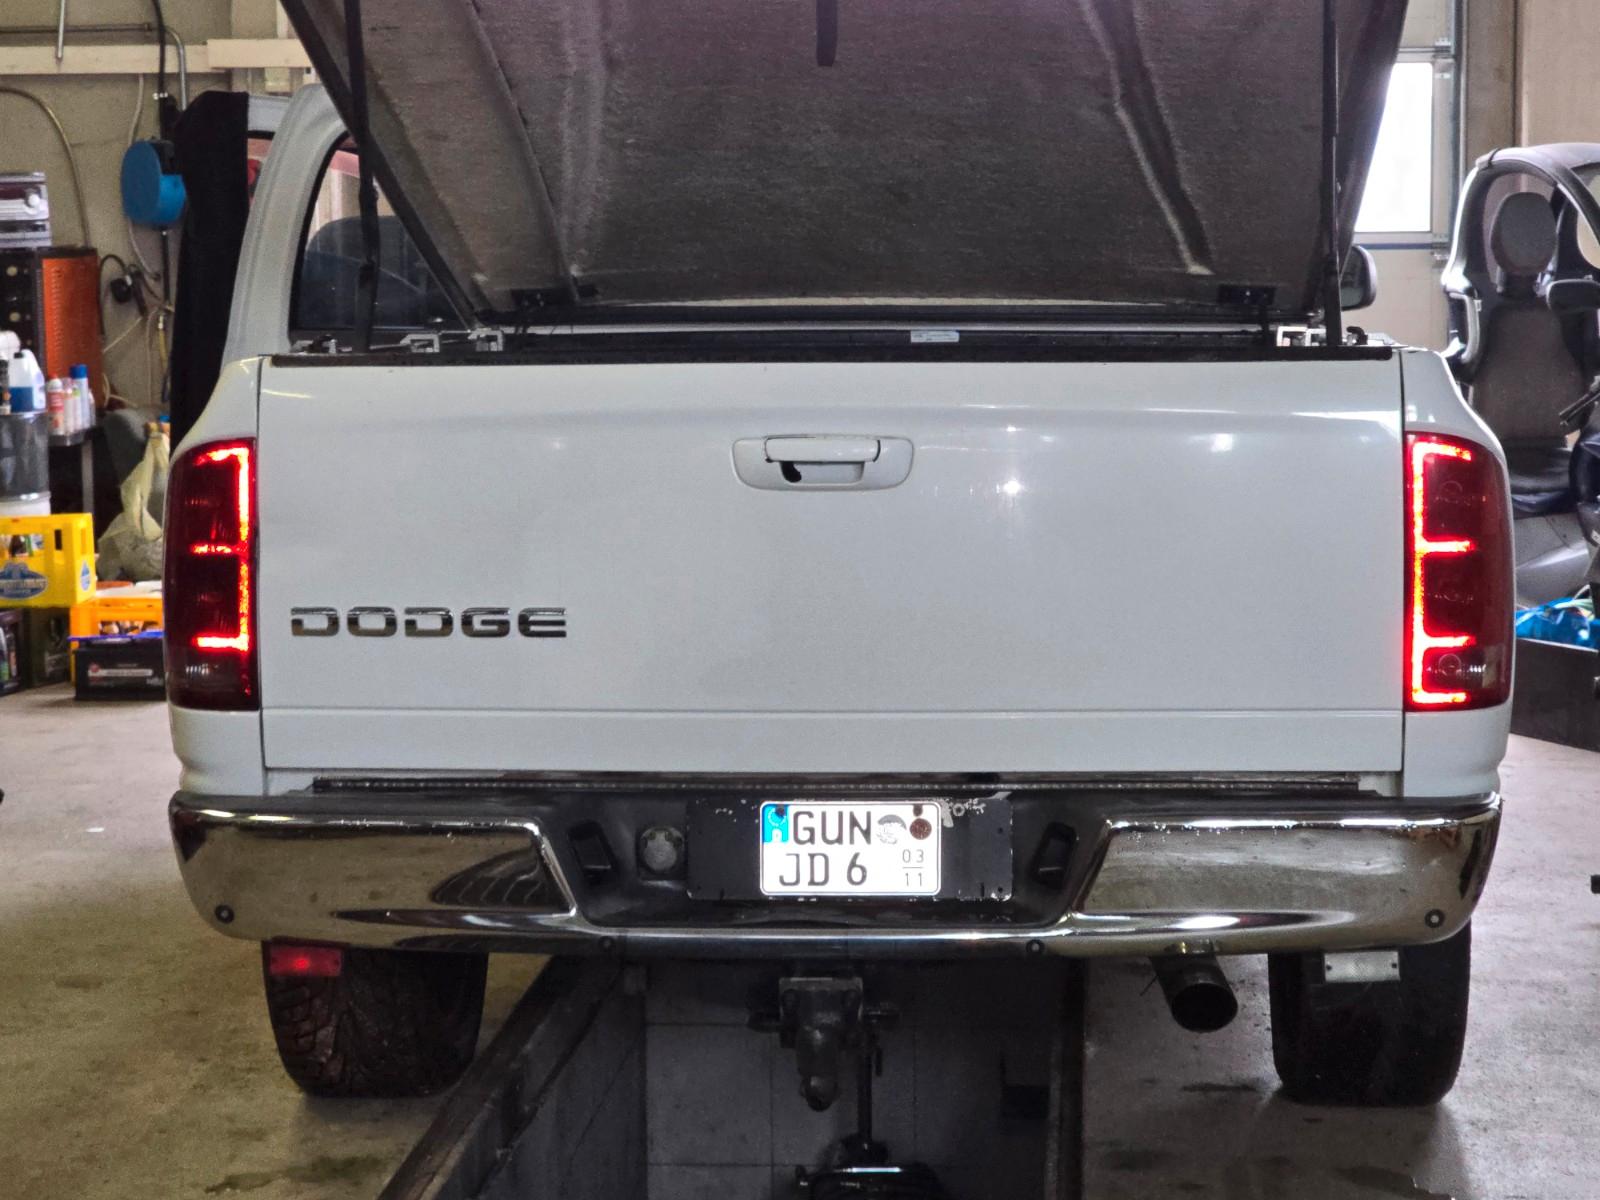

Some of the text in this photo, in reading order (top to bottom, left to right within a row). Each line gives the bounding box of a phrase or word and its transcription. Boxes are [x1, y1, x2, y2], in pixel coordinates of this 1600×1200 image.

[290, 606, 567, 638] DODGE
[793, 811, 871, 845] GUN
[779, 851, 868, 886] JD 6
[902, 848, 925, 864] 03
[904, 872, 923, 887] 11
